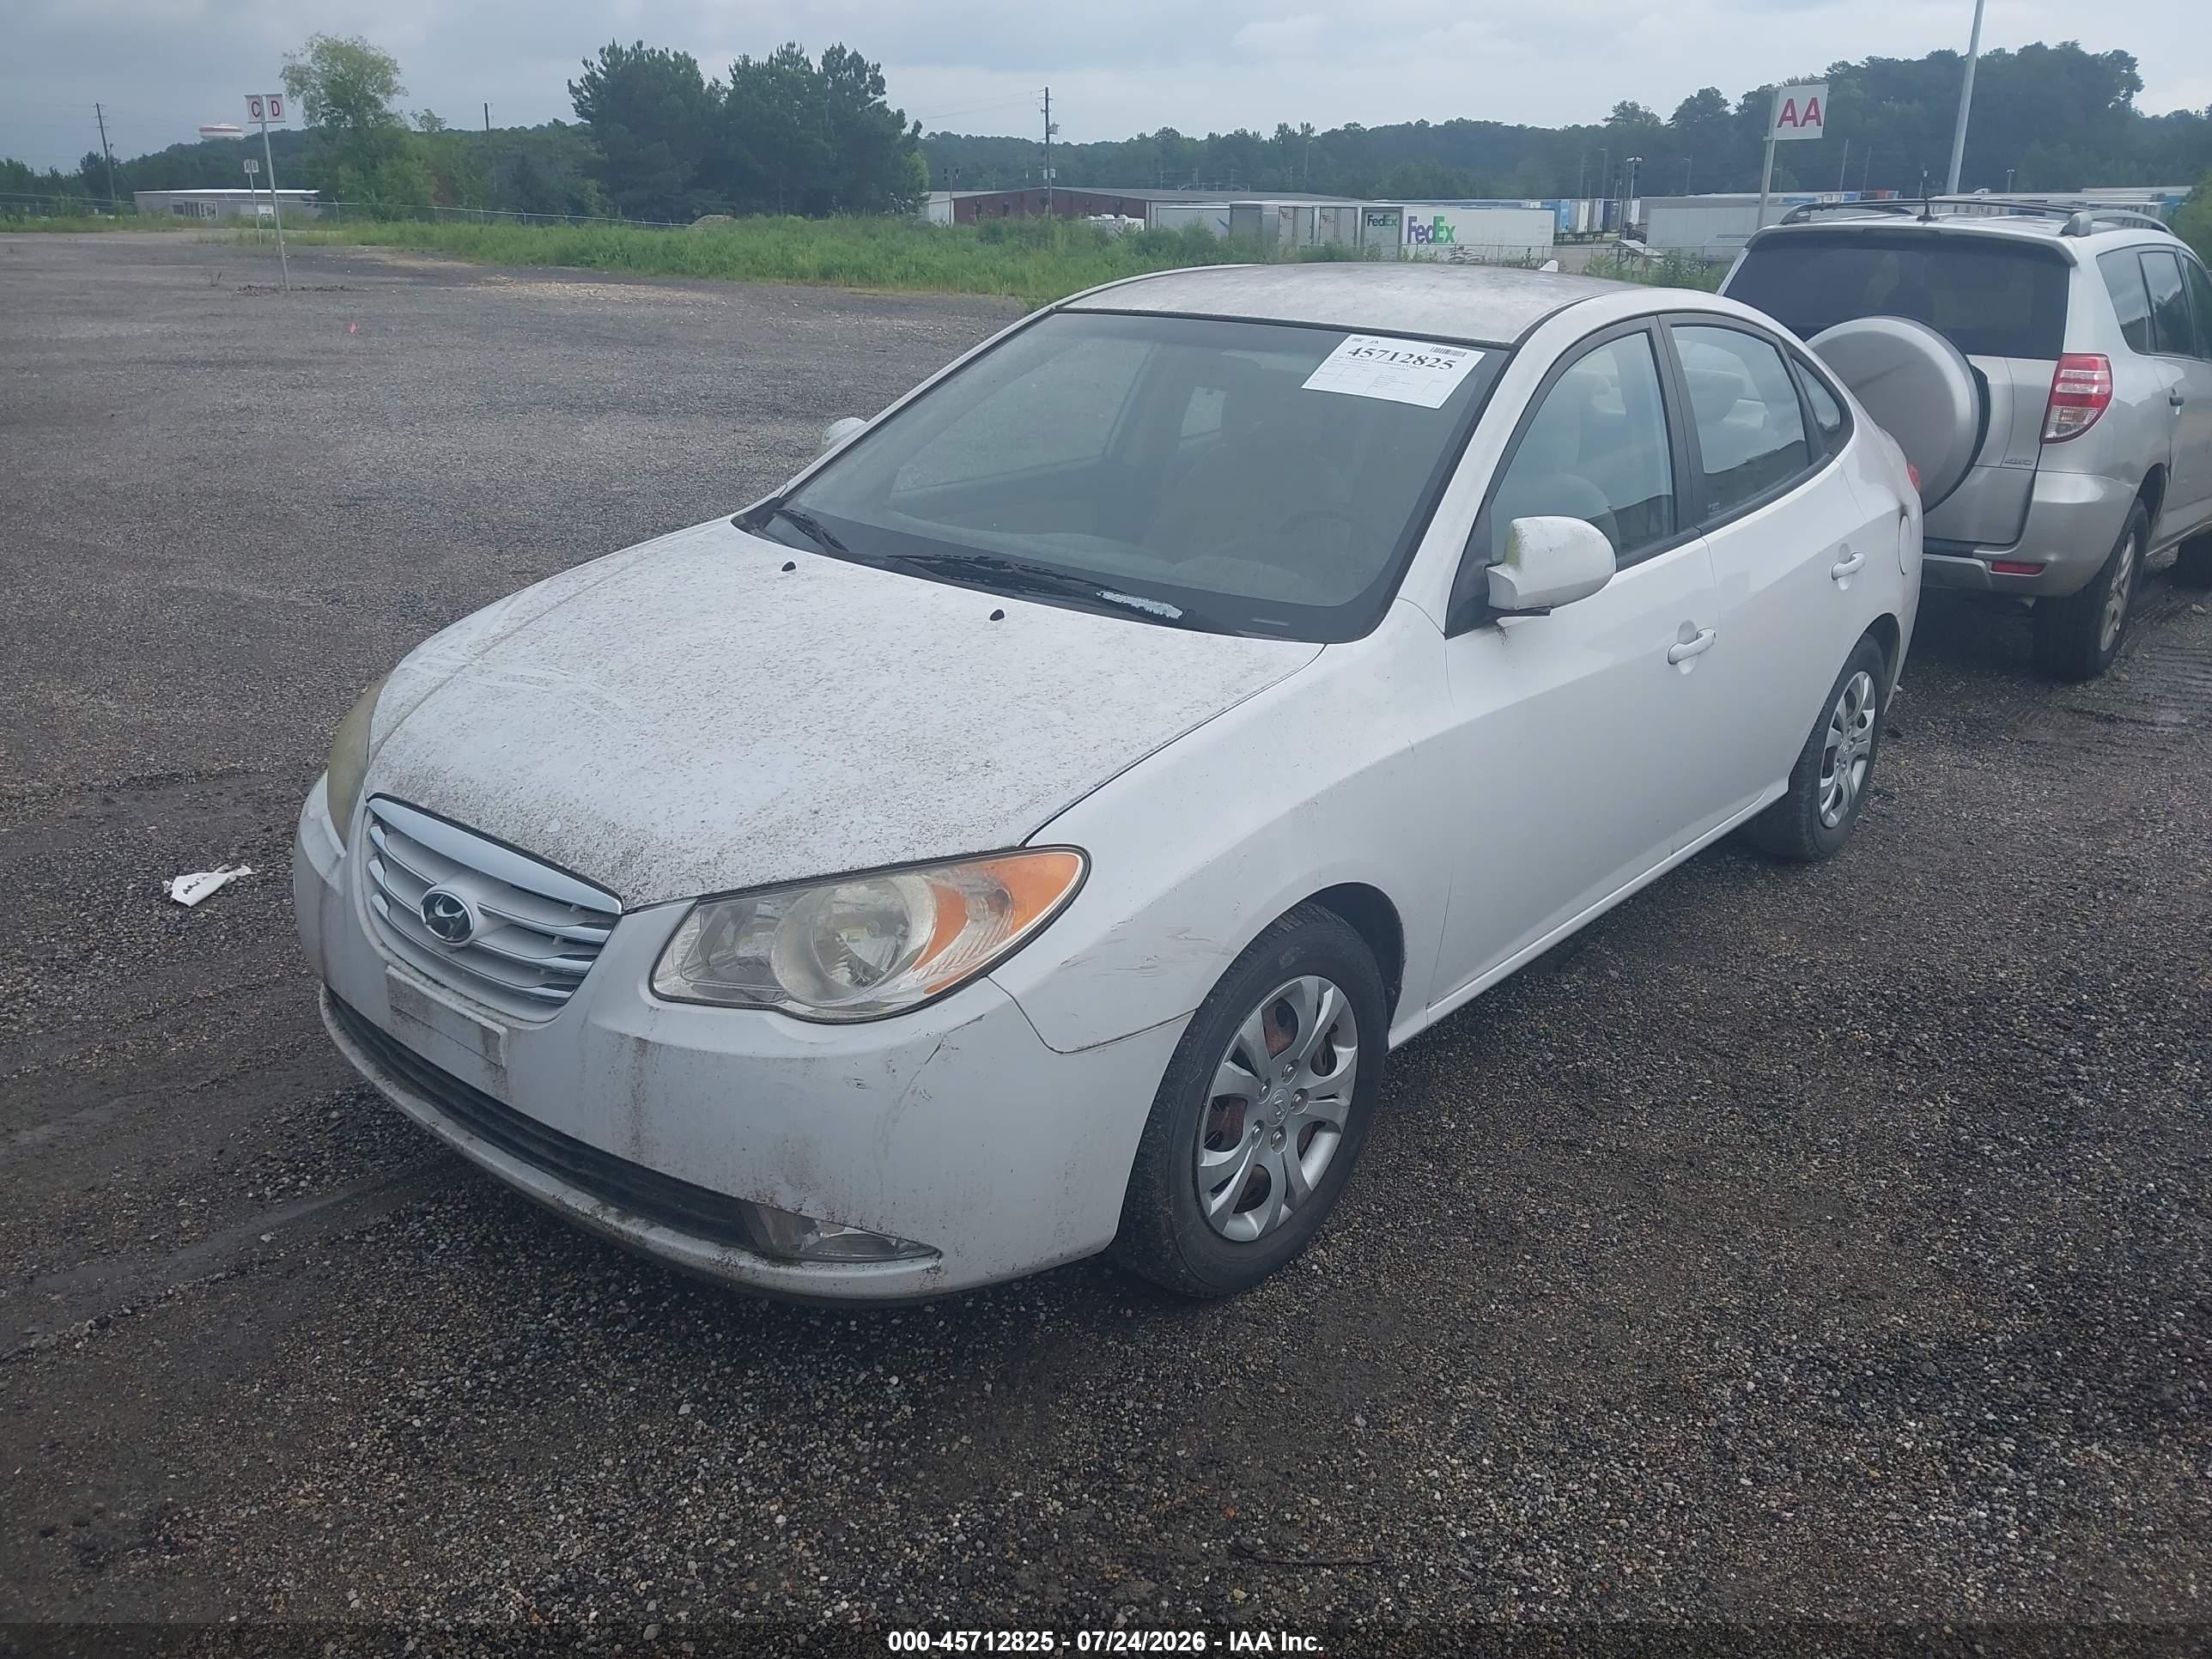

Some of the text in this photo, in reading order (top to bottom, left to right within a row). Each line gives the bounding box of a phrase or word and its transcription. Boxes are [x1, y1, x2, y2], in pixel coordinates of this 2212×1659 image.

[252, 100, 280, 118] C D
[1777, 97, 1822, 128] AA
[1367, 215, 1398, 227] FedEx
[1407, 216, 1456, 244] FedEx
[1347, 347, 1457, 371] 45712825
